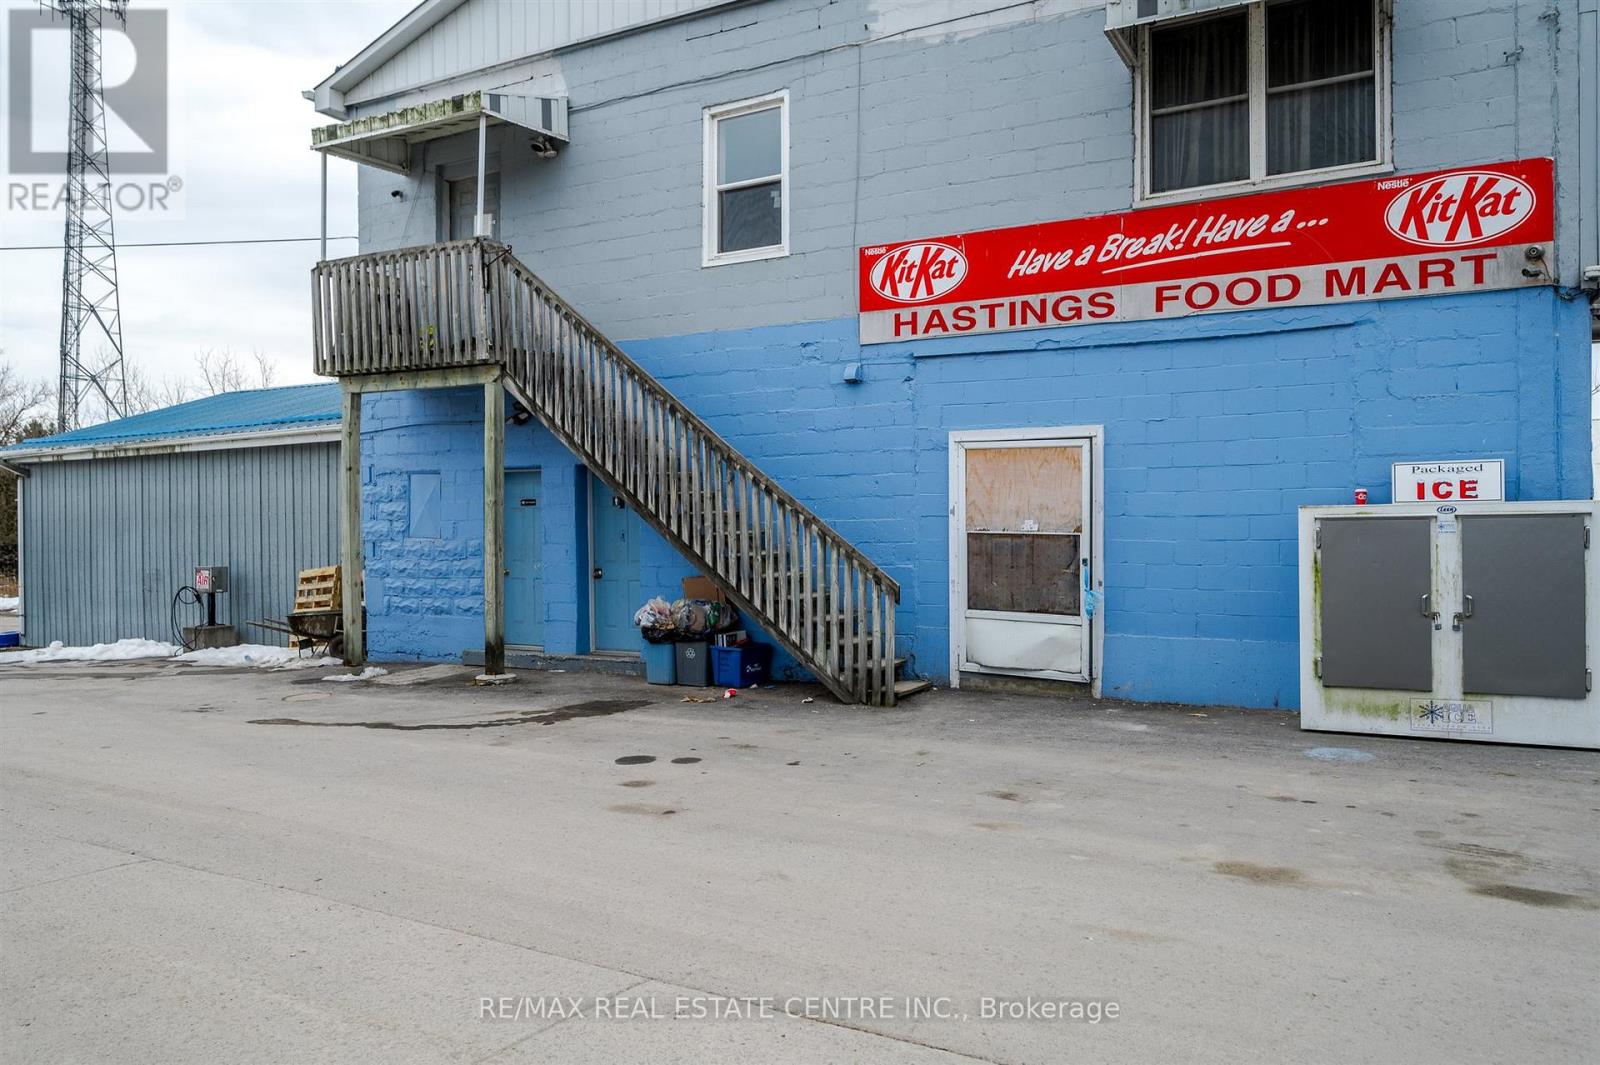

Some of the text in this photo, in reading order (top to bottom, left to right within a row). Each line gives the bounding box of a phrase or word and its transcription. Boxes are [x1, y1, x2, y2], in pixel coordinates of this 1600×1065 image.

[1007, 248, 1073, 279] Have
[1074, 245, 1095, 266] a
[1097, 218, 1198, 263] Break!
[1192, 214, 1269, 247] Have
[893, 253, 1498, 337] HASTINGS FOOD MART
[1412, 463, 1483, 474] Packaged
[1416, 479, 1479, 500] ICE
